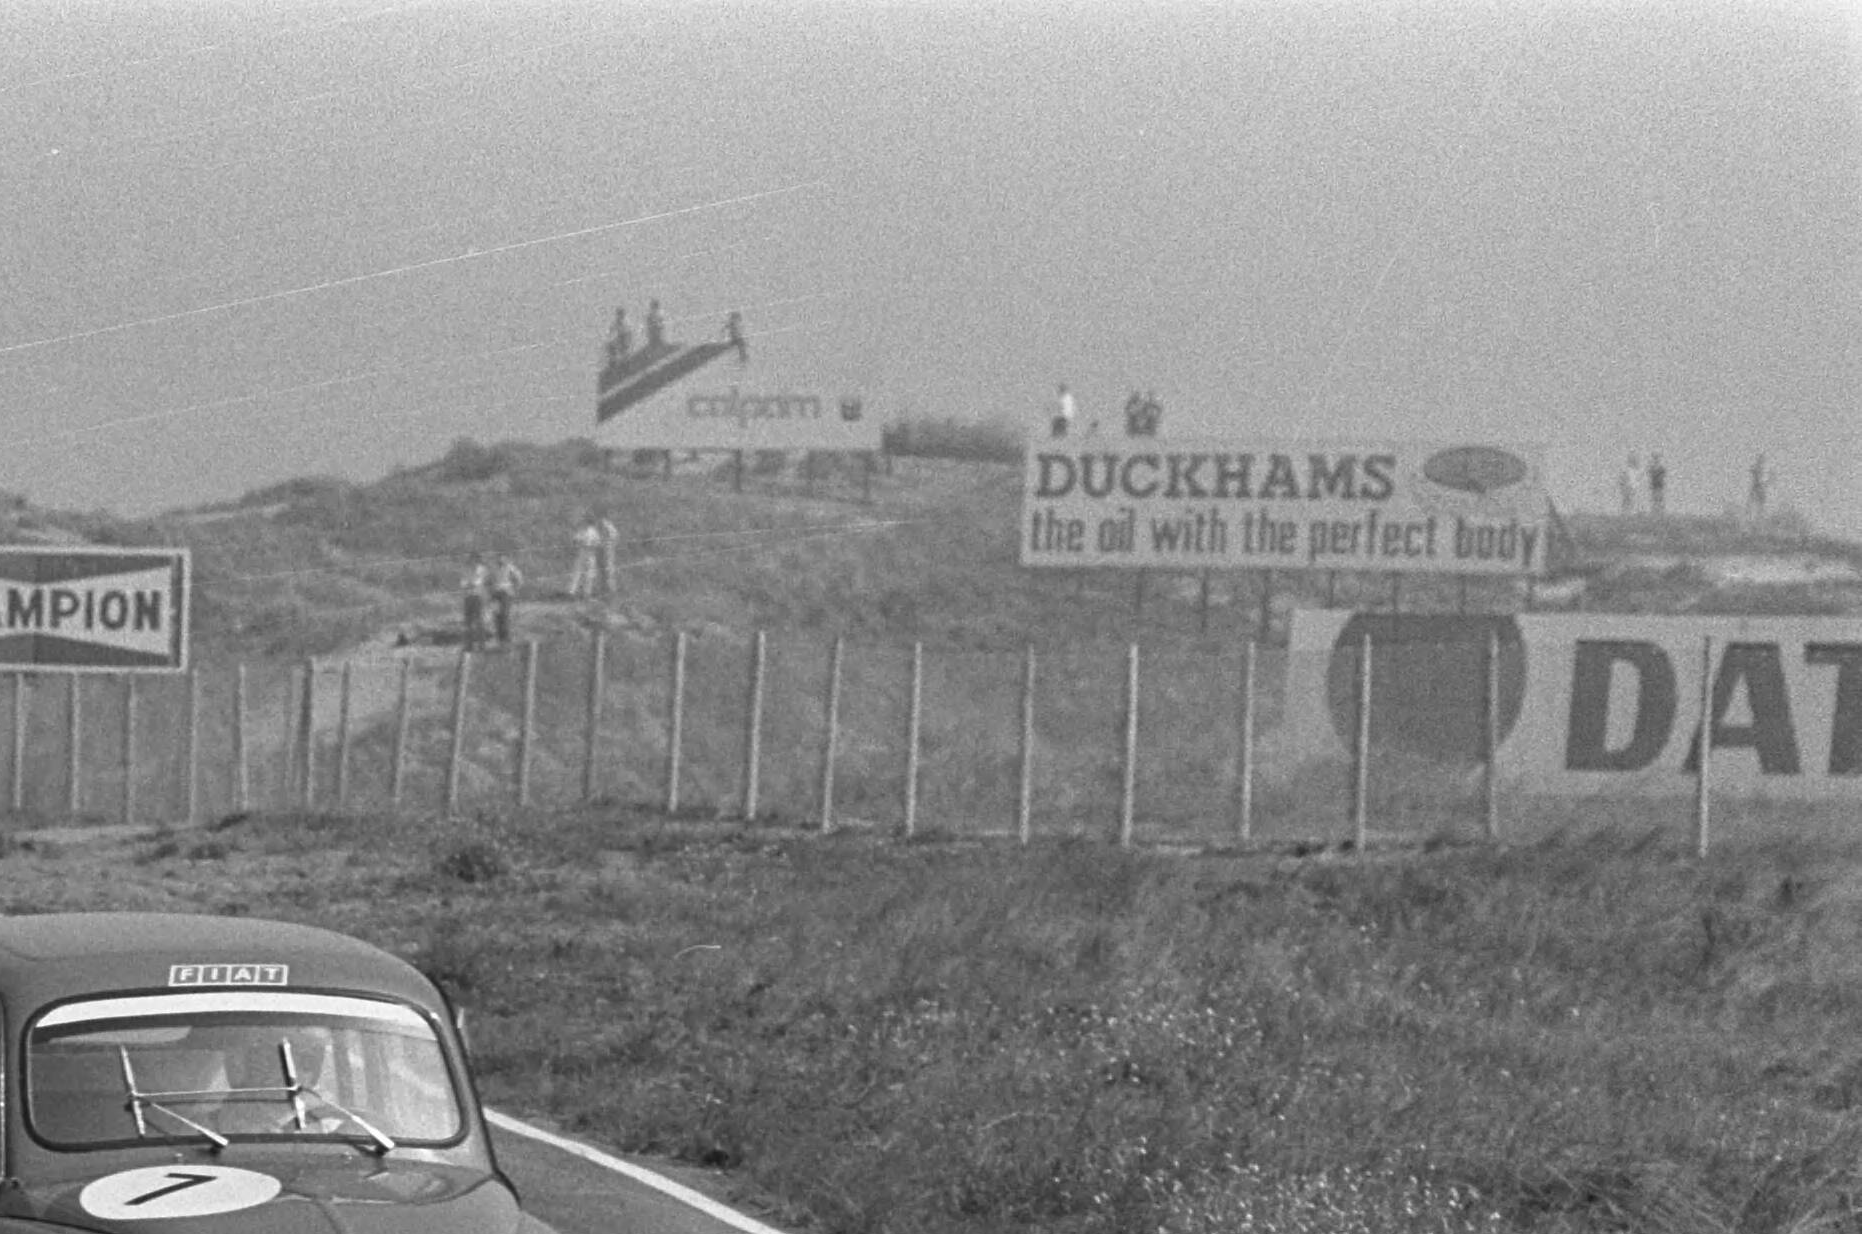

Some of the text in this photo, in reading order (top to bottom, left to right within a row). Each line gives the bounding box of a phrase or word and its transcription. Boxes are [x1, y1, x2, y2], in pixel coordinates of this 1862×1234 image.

[1037, 453, 1396, 500] DUCKHAMS
[1031, 507, 1539, 567] the oil with the perfect body
[179, 966, 280, 982] FIAT
[123, 1172, 219, 1206] 7
